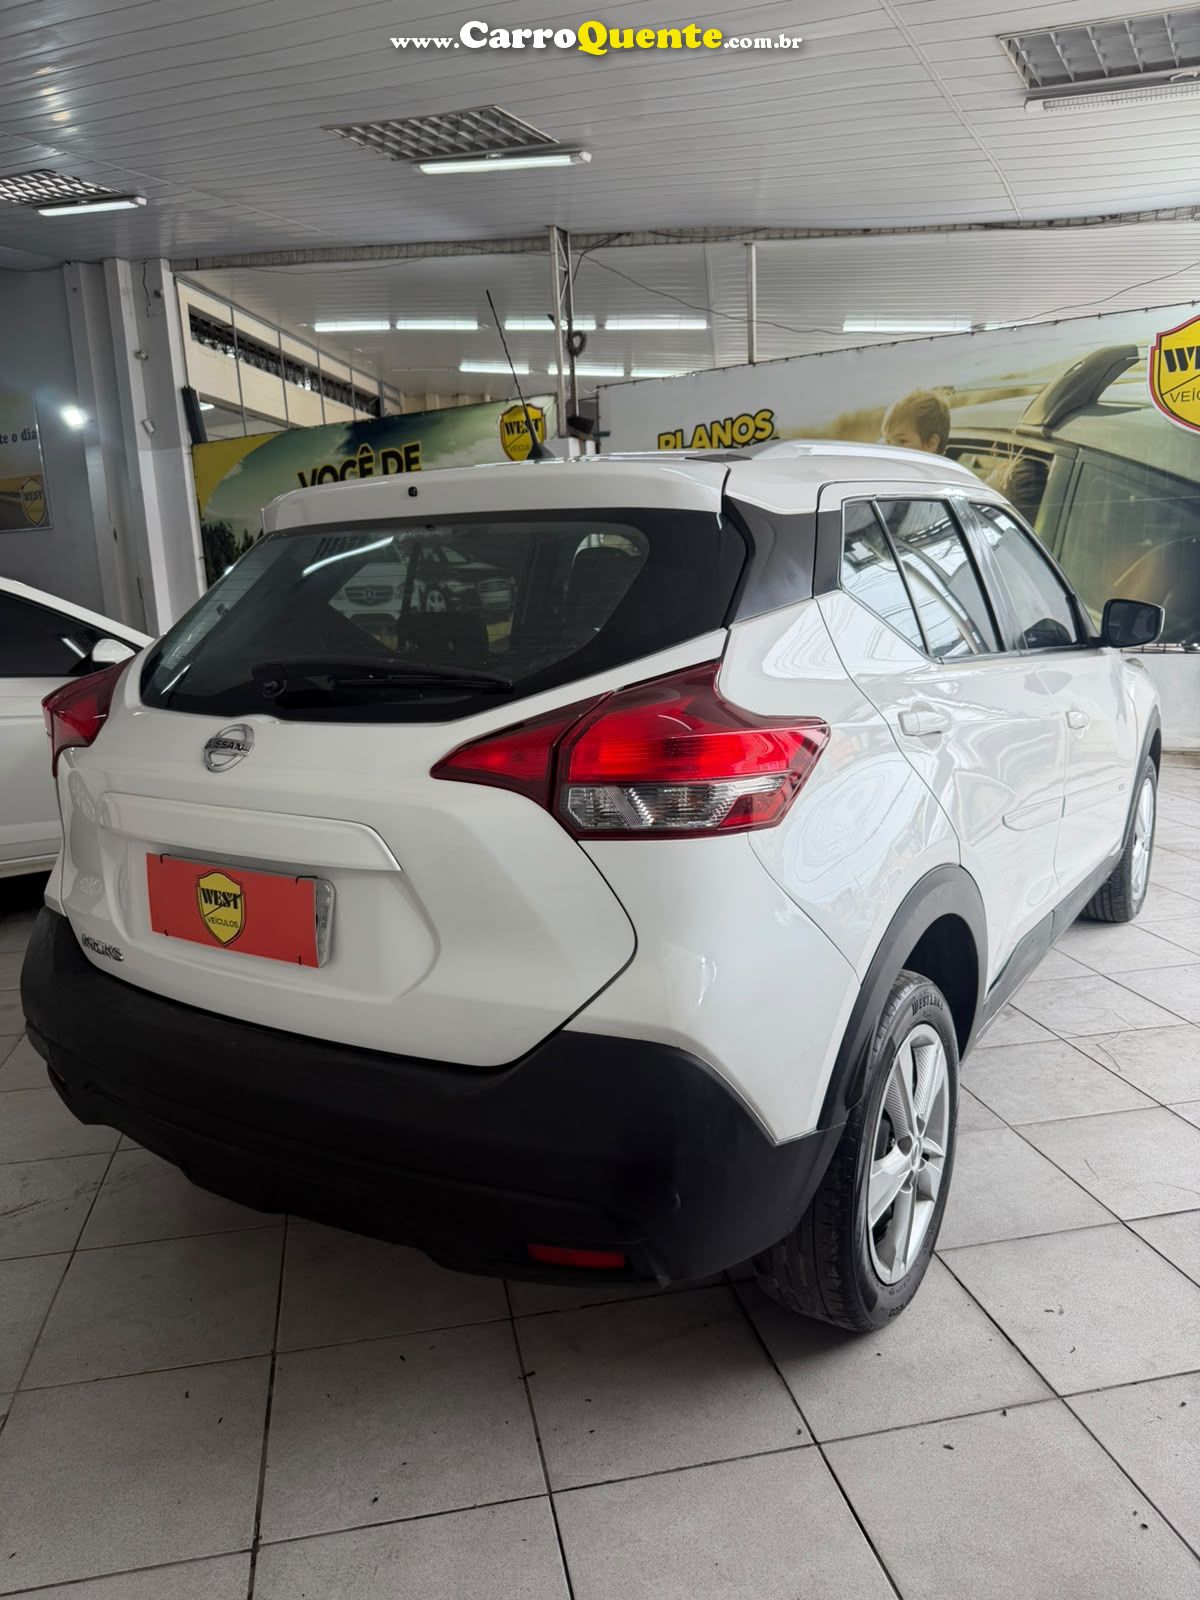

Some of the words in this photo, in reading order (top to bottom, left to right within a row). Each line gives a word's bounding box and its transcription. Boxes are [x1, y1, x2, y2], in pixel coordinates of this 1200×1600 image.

[11, 432, 18, 443] o
[20, 427, 37, 442] dia
[657, 408, 775, 449] PLANOS
[297, 443, 375, 488] VOCÊ
[380, 441, 421, 476] DE
[201, 887, 240, 909] WEST
